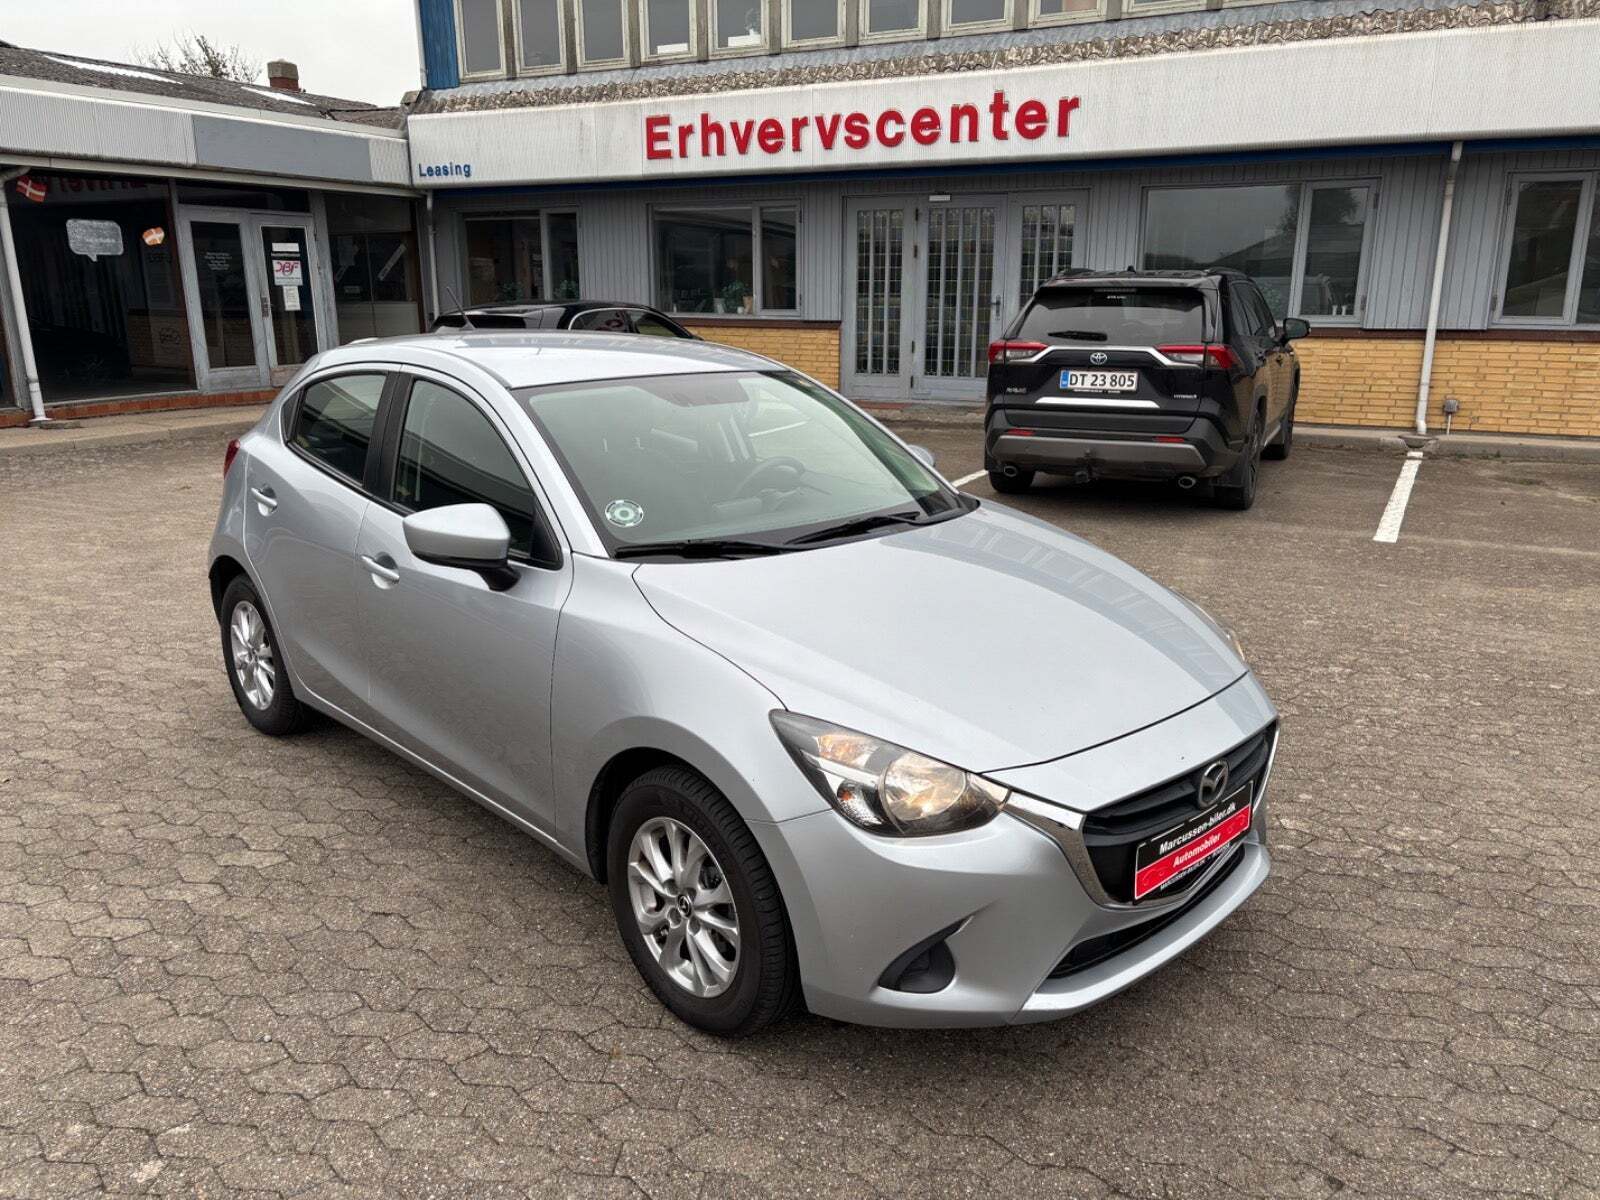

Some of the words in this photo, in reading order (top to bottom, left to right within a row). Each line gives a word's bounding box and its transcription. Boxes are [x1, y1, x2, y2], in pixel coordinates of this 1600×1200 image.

[645, 90, 1080, 160] Erhvervscenter
[418, 161, 472, 178] Leasing
[1069, 373, 1088, 386] DT
[1090, 374, 1107, 387] 23
[1109, 374, 1135, 388] 805
[1160, 802, 1236, 855] Marcussen-biler.dk
[1173, 833, 1221, 868] Automobiler
